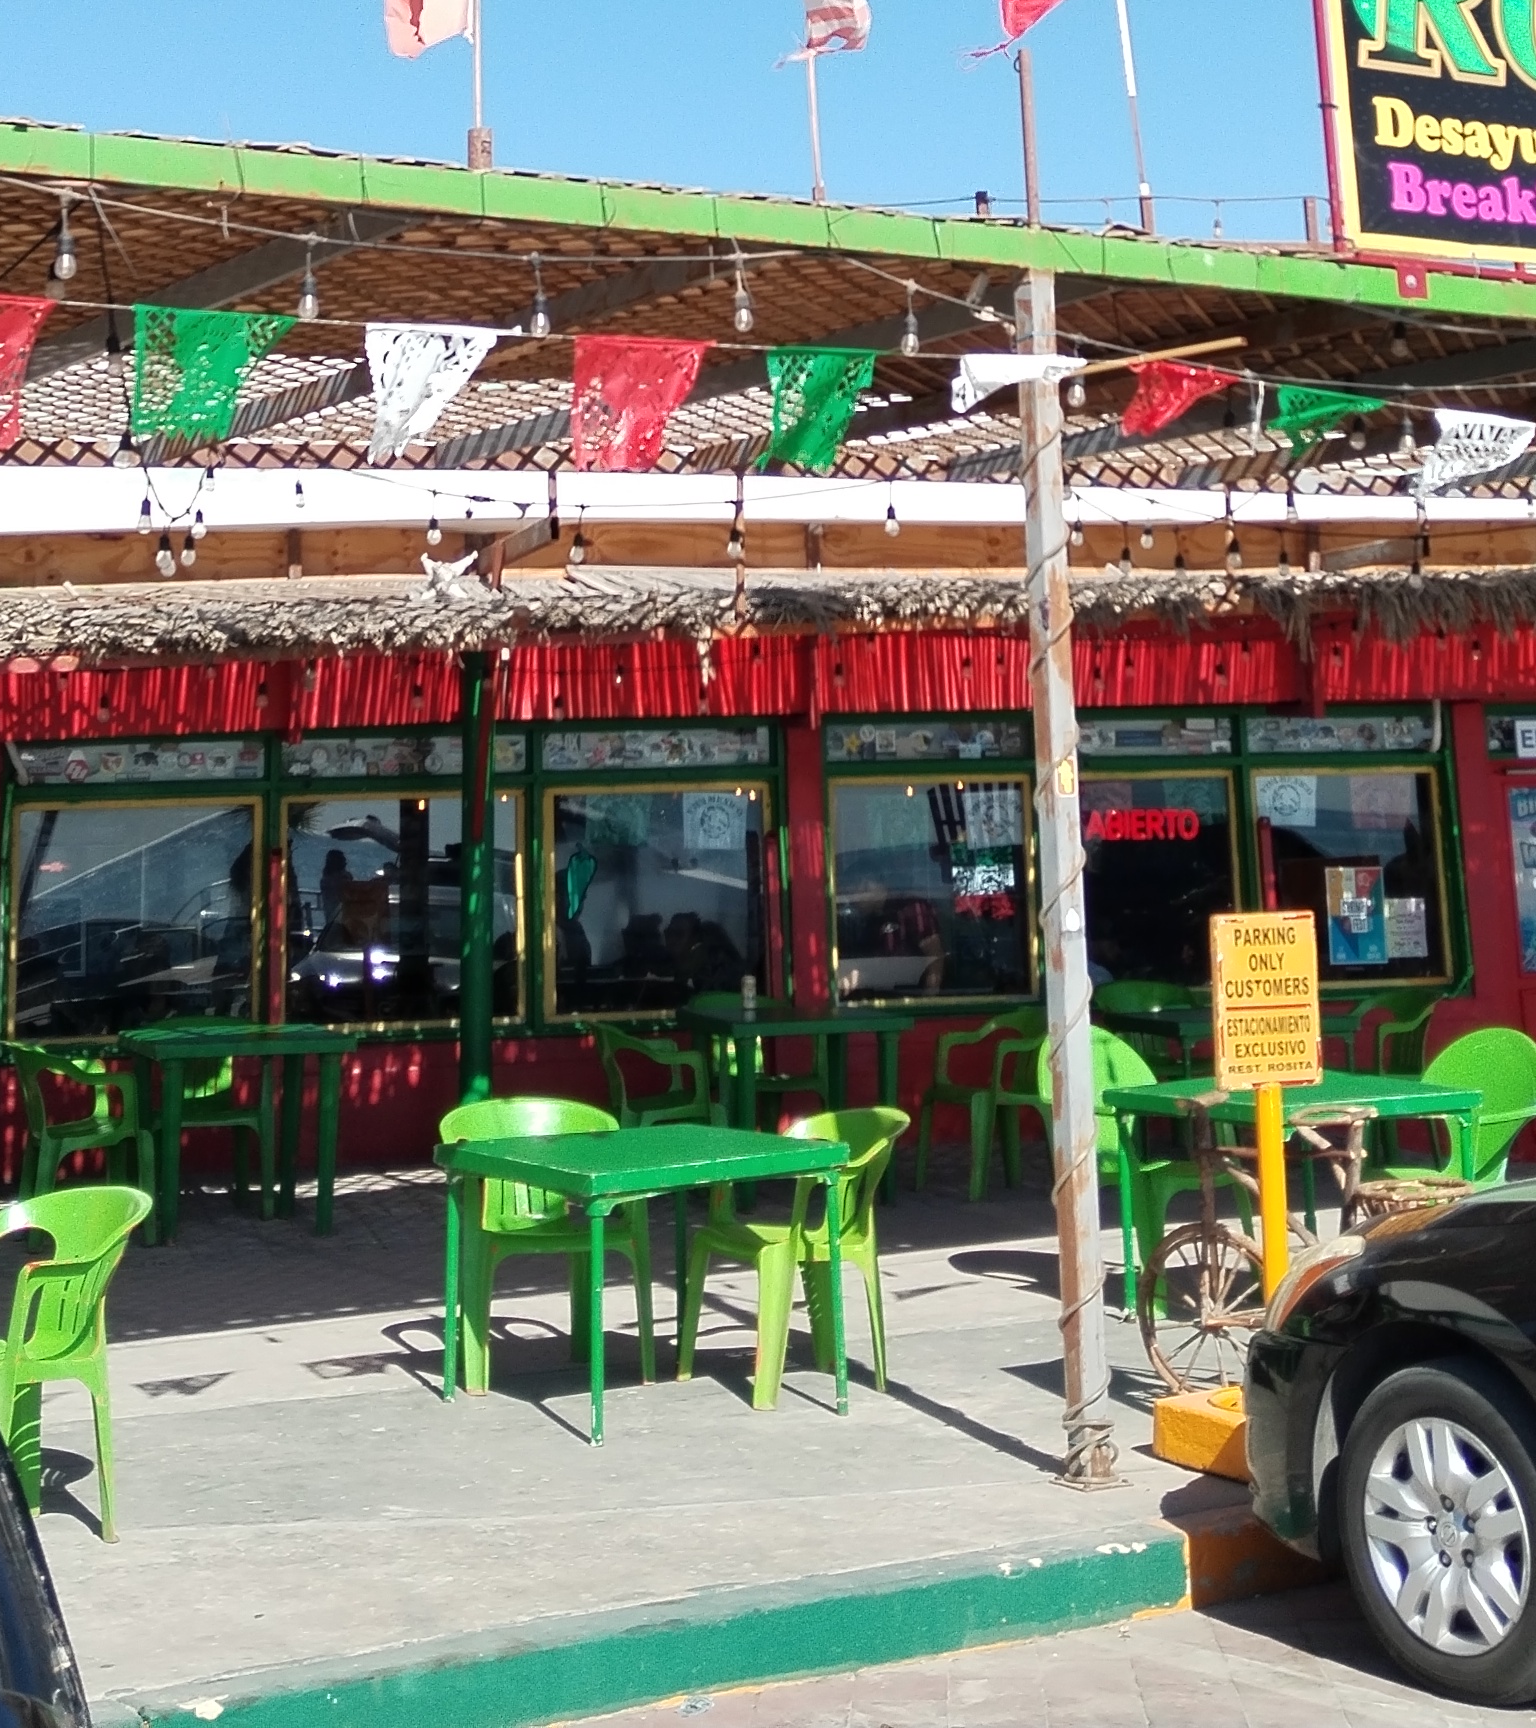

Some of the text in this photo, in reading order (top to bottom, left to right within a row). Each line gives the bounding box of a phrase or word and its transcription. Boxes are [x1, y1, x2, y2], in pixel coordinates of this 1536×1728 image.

[1085, 807, 1200, 841] ABIERTO
[1233, 927, 1296, 947] PARKING
[1249, 952, 1285, 972] ONLY
[1225, 976, 1310, 998] CUSTOMERS
[1227, 1015, 1311, 1037] ESTACIONAMIENTO
[1235, 1039, 1307, 1059] EXCLUSIVO
[1228, 1061, 1314, 1074] REST. ROSITA
